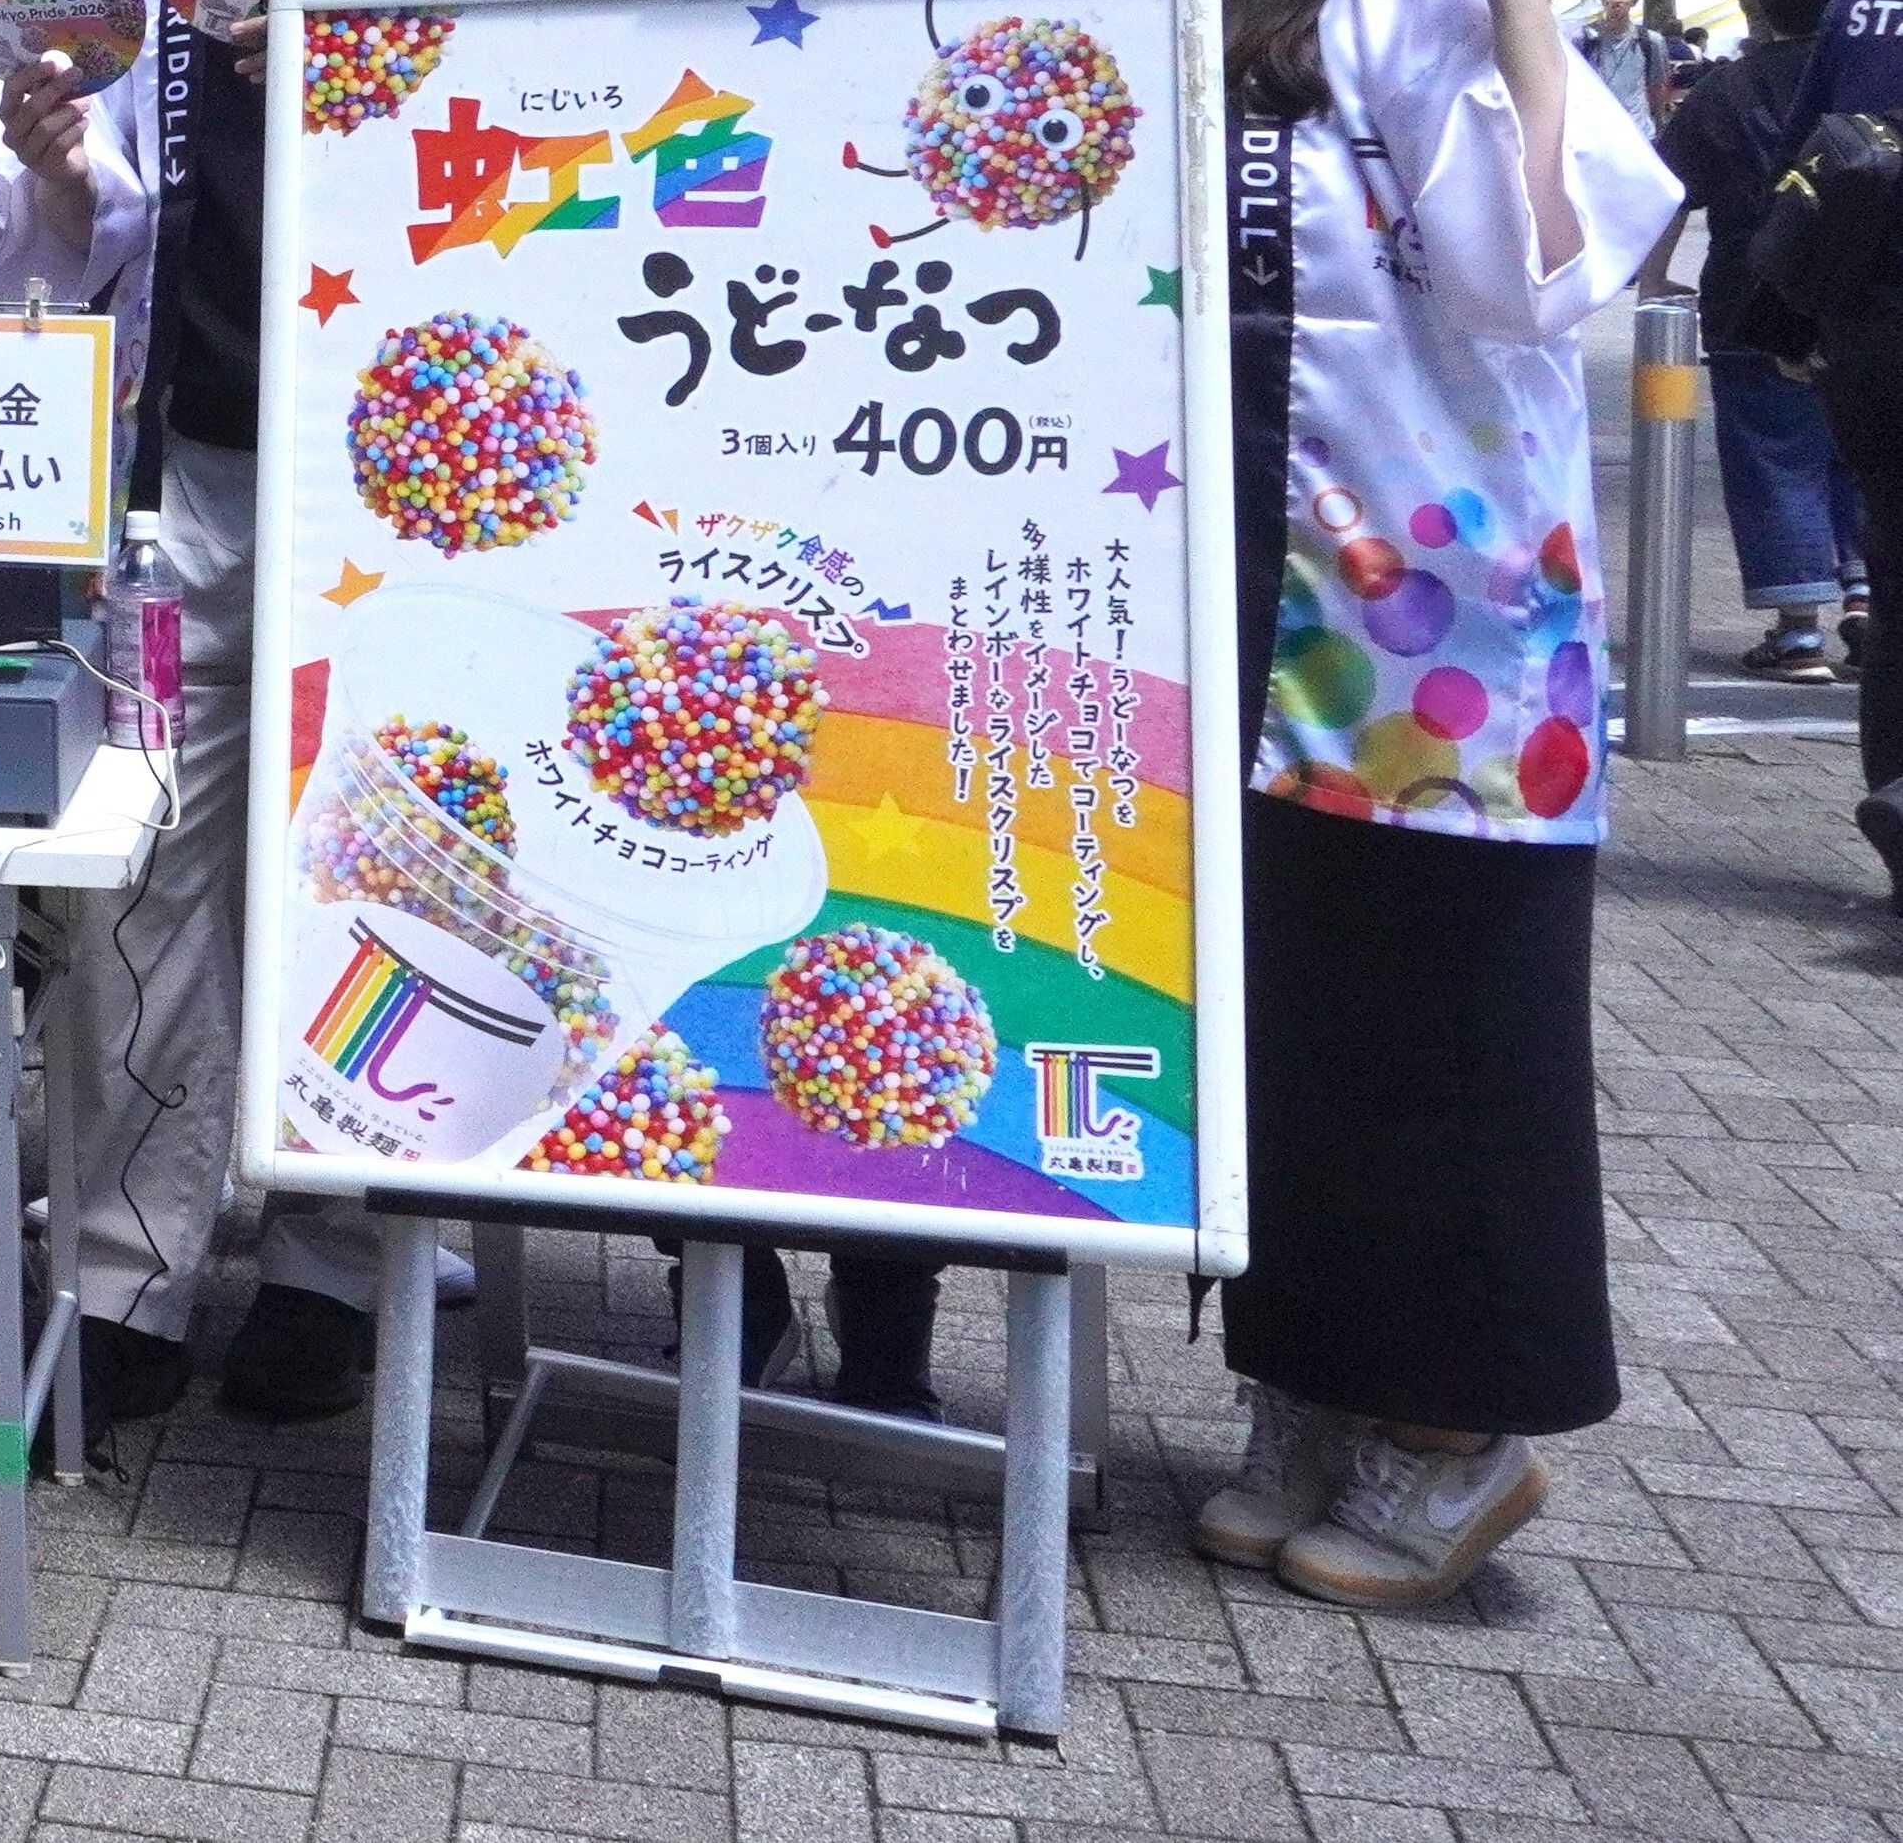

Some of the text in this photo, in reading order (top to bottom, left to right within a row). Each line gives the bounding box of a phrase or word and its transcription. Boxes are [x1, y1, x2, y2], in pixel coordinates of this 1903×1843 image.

[28, 5, 66, 19] Pride
[69, 3, 105, 16] 2026
[520, 86, 624, 112] にじいろ
[406, 68, 773, 265] 虹色
[617, 252, 1061, 407] うどーなつ
[721, 400, 1069, 477] 3個入り 400円
[659, 547, 864, 653] ライスクリスプ
[696, 513, 864, 596] ザクザク食感の
[1018, 518, 1058, 785] 多様性をイメージした
[985, 549, 1023, 950] レインボーなライスクリスプを
[284, 1074, 402, 1157] 丸亀製麺
